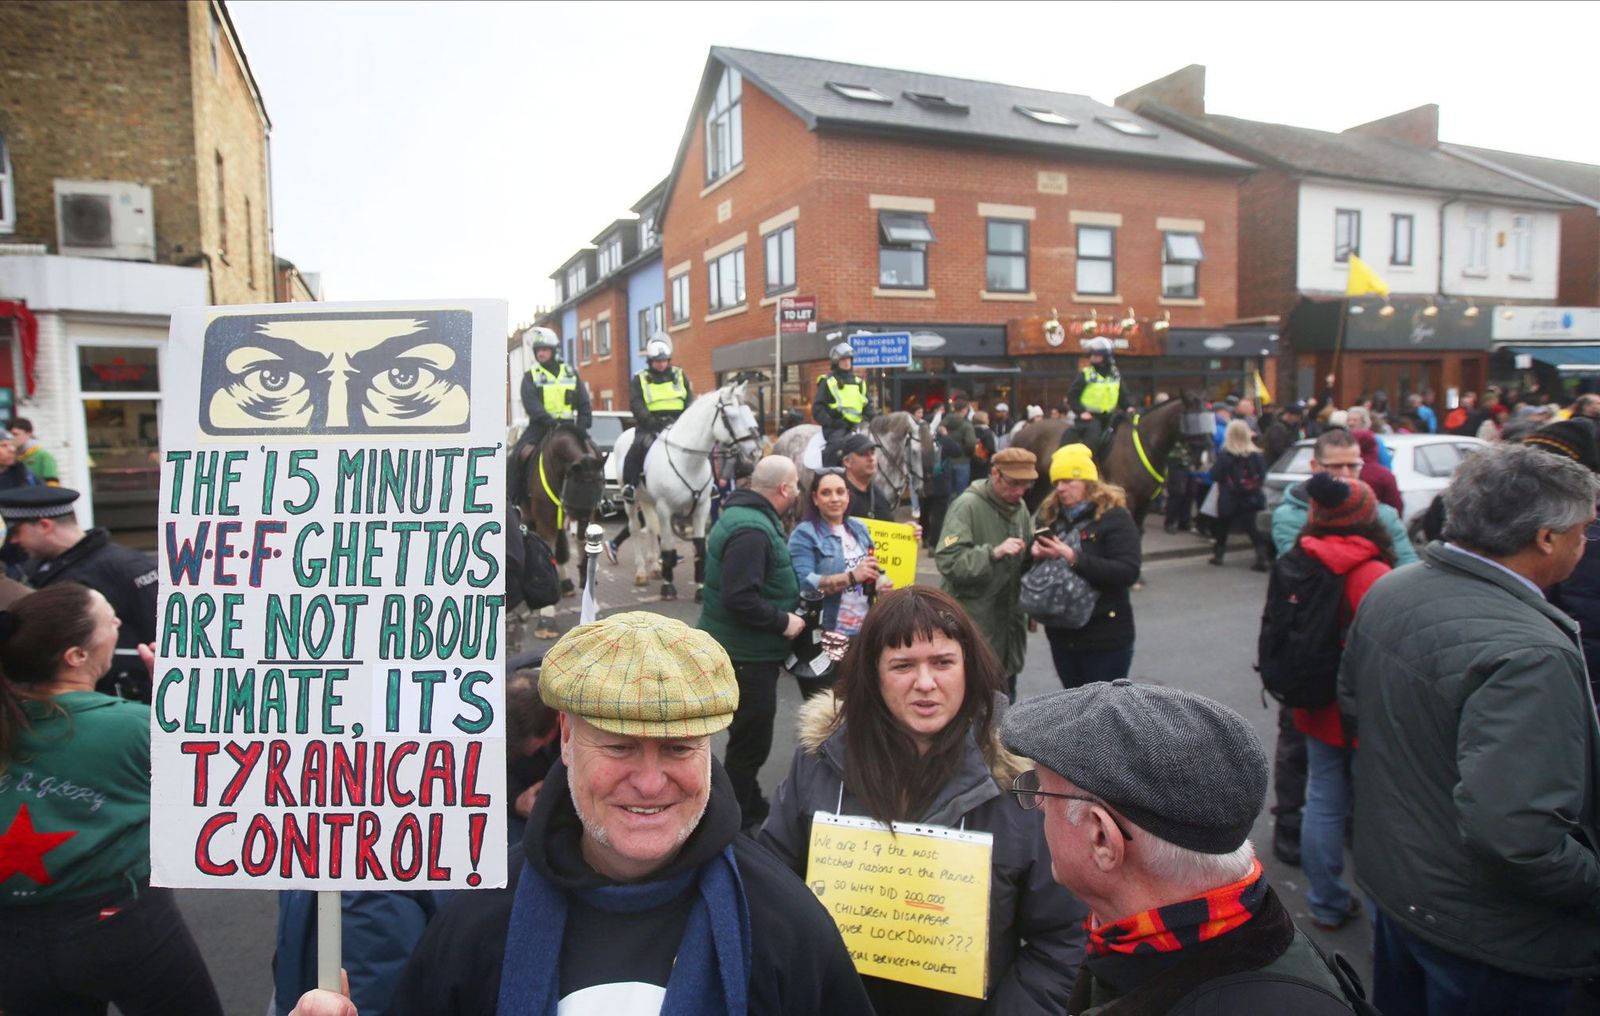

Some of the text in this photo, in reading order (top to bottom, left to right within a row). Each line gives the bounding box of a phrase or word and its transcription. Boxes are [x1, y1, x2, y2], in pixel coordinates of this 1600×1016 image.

[784, 309, 813, 319] TO LET
[853, 338, 866, 346] No
[868, 338, 895, 346] access
[897, 337, 907, 345] to
[881, 345, 903, 353] Road
[881, 354, 907, 362] cycles
[166, 451, 248, 515] THE
[874, 530, 889, 538] min
[891, 532, 912, 541] cities
[293, 522, 501, 588] GHETTOS
[891, 556, 902, 566] ID
[160, 593, 506, 660] ARE NOT ABOUT
[155, 667, 494, 740] CLIMATE, IT'S
[181, 741, 491, 807] TYRANICAL
[814, 832, 832, 848] We
[836, 841, 857, 852] are
[888, 843, 908, 858] the
[899, 866, 913, 877] on
[918, 868, 934, 879] the
[834, 880, 946, 905] SO WHY DID 200,000
[834, 902, 951, 926] CHILDREN DISAPPEAR
[922, 960, 957, 975] COURTS
